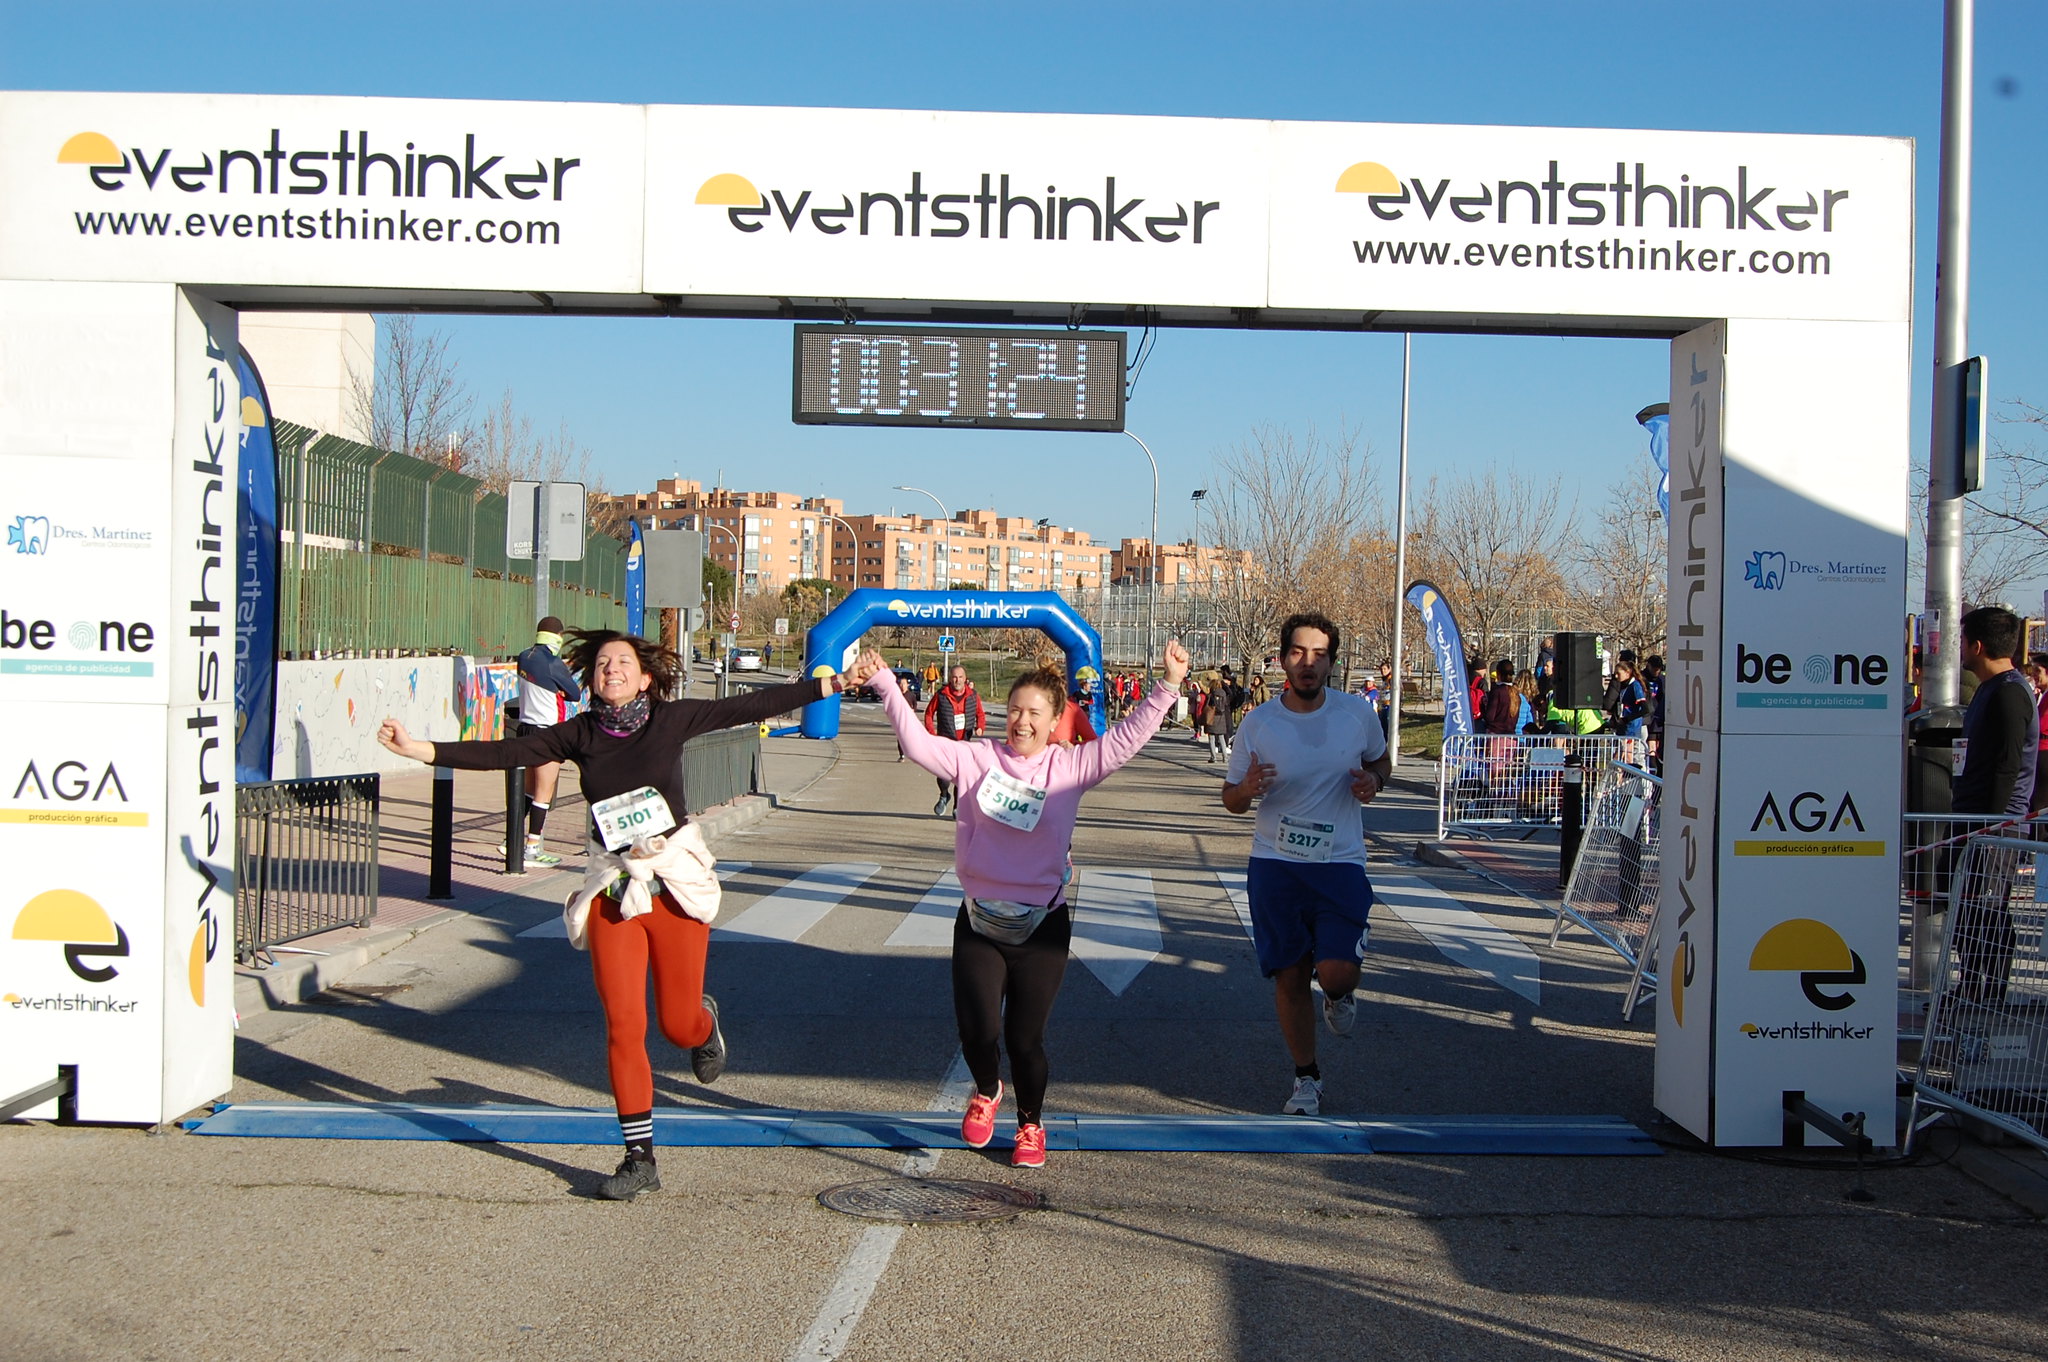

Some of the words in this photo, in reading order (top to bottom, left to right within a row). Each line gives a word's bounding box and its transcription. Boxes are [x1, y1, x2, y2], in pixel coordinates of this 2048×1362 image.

[90, 128, 581, 201] eventsthinker
[728, 171, 1220, 244] eventsthinker
[1368, 160, 1848, 233] eventsthinker
[74, 206, 561, 245] www.eventsthinker.com
[1352, 238, 1831, 275] www.eventsthinker.com
[53, 525, 88, 539] Dres.
[1789, 560, 1824, 574] Dres.
[1828, 561, 1887, 575] Martínez
[1817, 575, 1842, 583] Centros
[897, 599, 1032, 619] eventsthinker
[1, 609, 55, 650] be
[187, 322, 226, 964] eventsthinker
[25, 663, 64, 673] agencia
[65, 662, 78, 672] de
[79, 663, 131, 674] publicidad
[1676, 352, 1711, 987] eventsthinker
[1736, 643, 1792, 685] be
[1760, 697, 1798, 706] agencia
[1800, 696, 1812, 705] de
[1814, 696, 1865, 707] publicidad
[13, 760, 128, 802] AGA
[992, 792, 1030, 815] 5104
[1750, 790, 1866, 833] AGA
[28, 813, 82, 823] producción
[85, 813, 119, 824] gráfica
[617, 808, 652, 830] 5101
[1287, 832, 1322, 848] 5217
[1766, 843, 1819, 854] producción
[1821, 843, 1855, 855] gráfica
[11, 993, 138, 1013] eventsthinker
[1747, 1021, 1875, 1040] eventsthinker
